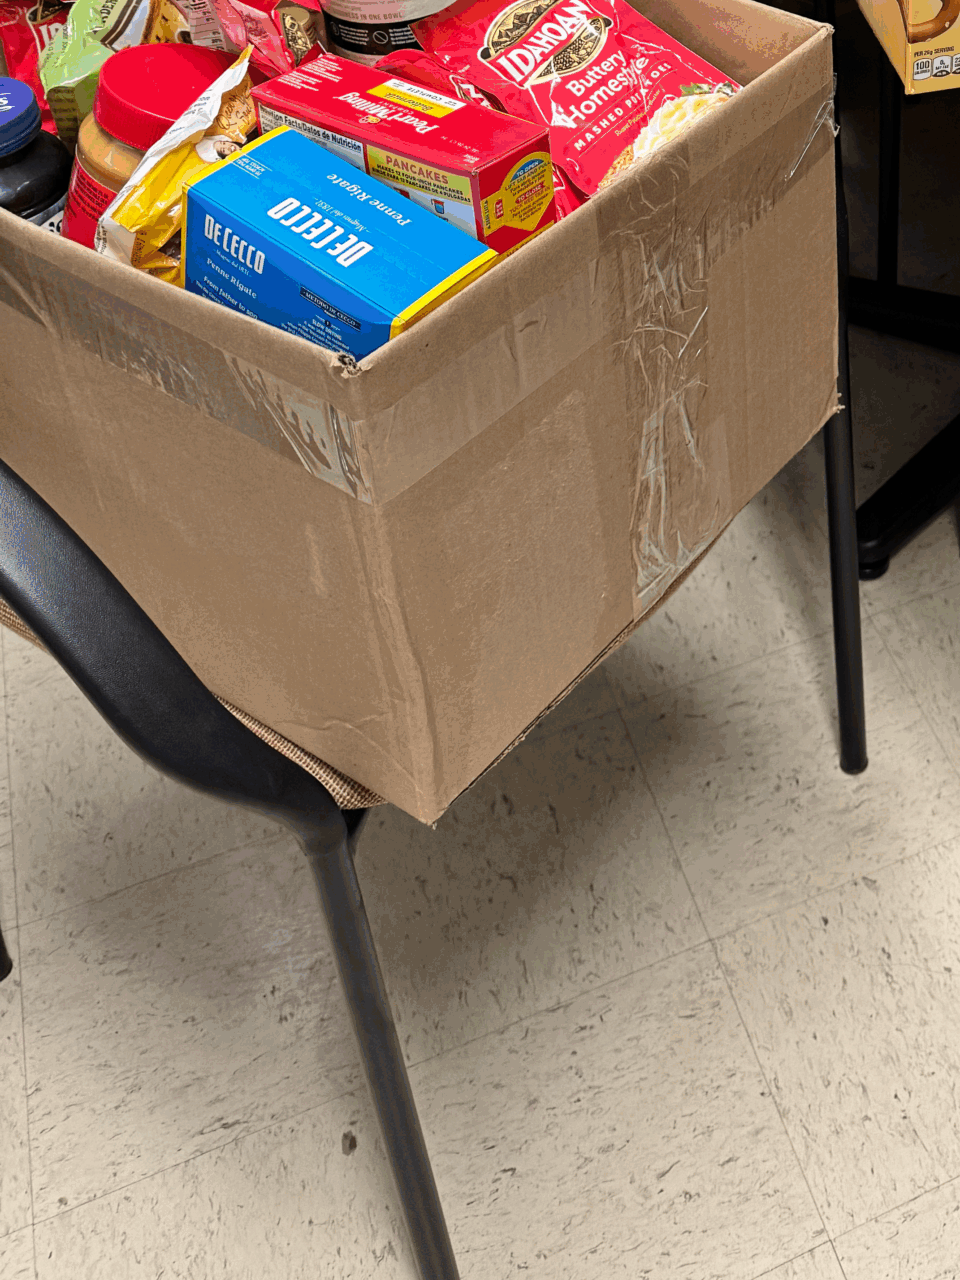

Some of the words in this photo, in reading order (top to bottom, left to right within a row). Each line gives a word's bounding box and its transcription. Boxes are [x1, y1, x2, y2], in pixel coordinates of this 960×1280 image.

[916, 60, 930, 70] 100
[934, 46, 954, 55] SERVING
[565, 50, 628, 97] Buttery
[332, 92, 396, 119] Milling
[559, 55, 650, 130] Homestyle
[386, 113, 440, 134] Pearl
[573, 105, 625, 151] MASHED
[322, 130, 331, 140] de
[331, 133, 362, 152] Nutrición
[386, 155, 449, 185] PANCAKES
[326, 173, 372, 202] Rigate
[266, 196, 345, 250] CECCO
[369, 200, 413, 227] Penne
[204, 213, 222, 246] DE
[222, 227, 266, 275] CECCO
[326, 233, 374, 268] DE
[203, 275, 219, 289] From
[219, 287, 238, 306] father
[206, 257, 230, 280] Penne
[230, 275, 258, 299] Rigate
